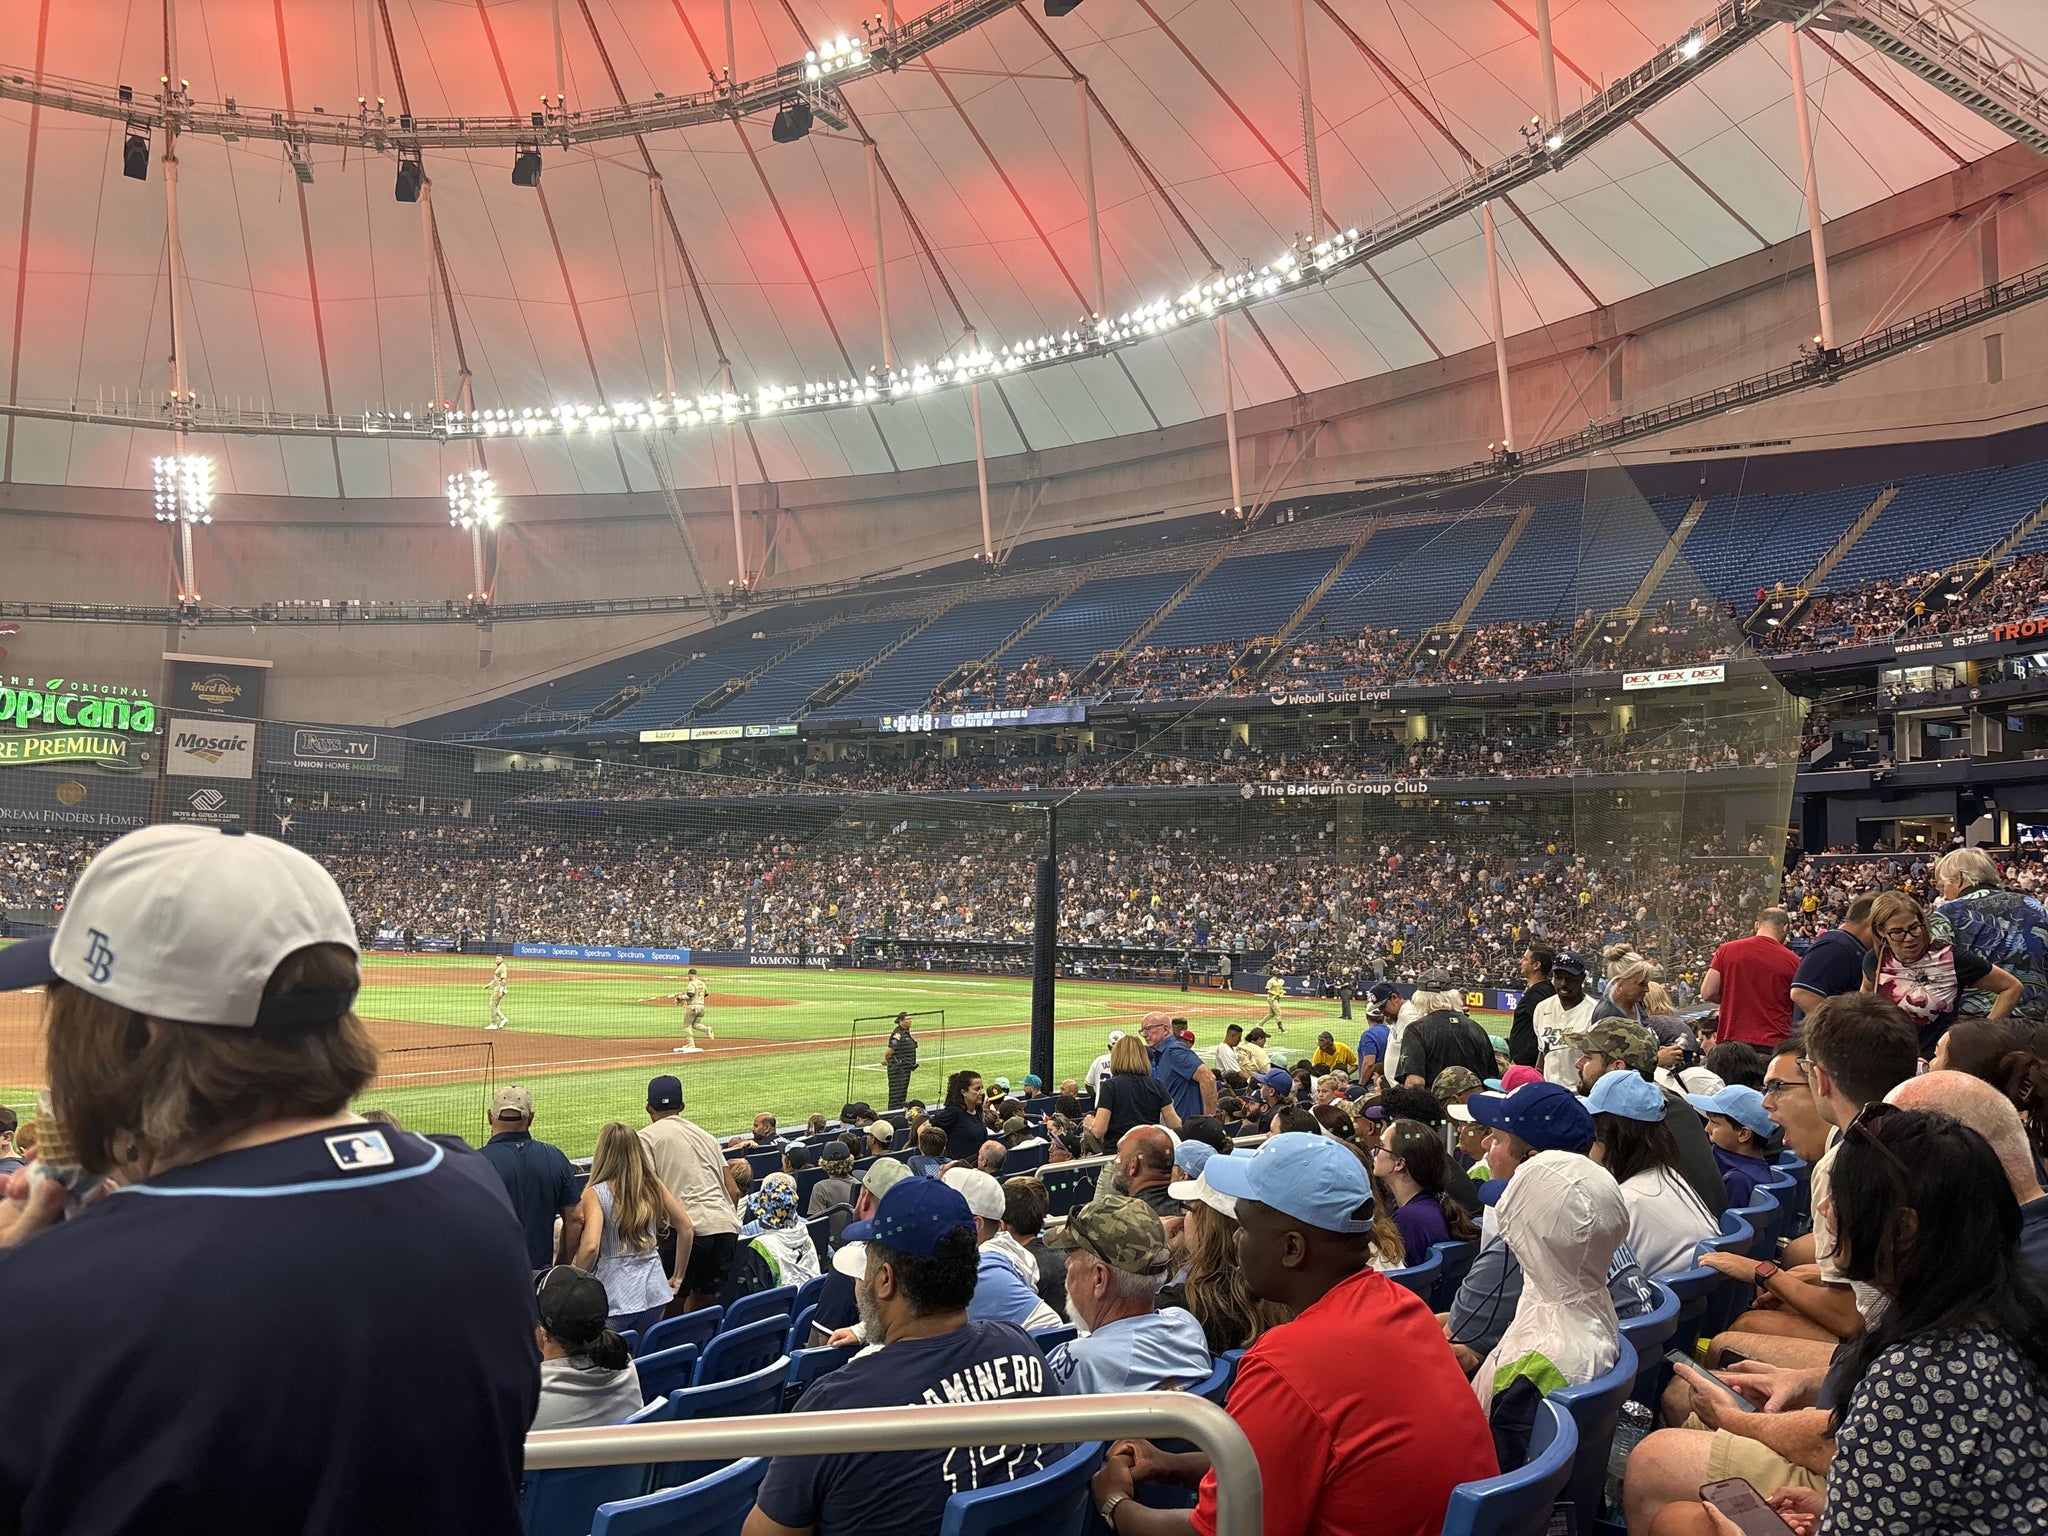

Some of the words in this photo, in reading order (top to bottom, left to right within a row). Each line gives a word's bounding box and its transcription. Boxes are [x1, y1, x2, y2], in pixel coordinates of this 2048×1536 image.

[1894, 643, 1923, 653] WQBN
[1953, 636, 1973, 647] 95.7
[1625, 674, 1652, 684] DEX
[1657, 671, 1685, 681] DEX
[1691, 668, 1719, 678] DEX
[70, 682, 149, 697] ORIGINAL
[191, 681, 217, 693] Hard
[217, 684, 242, 696] Rock
[1289, 692, 1325, 704] Webull
[1327, 691, 1357, 702] Suite
[1360, 688, 1390, 700] Level
[23, 736, 127, 757] PREMIUM
[174, 733, 248, 751] Mosaic
[294, 760, 323, 769] UNION
[324, 762, 351, 770] HOME
[352, 763, 400, 773] MORTGAGE
[1259, 785, 1285, 796] The
[1287, 783, 1344, 796] Baldwin
[1347, 784, 1391, 796] Group
[1394, 781, 1428, 793] Club
[44, 810, 95, 823] FINDERS
[99, 813, 144, 826] HOMES
[83, 927, 115, 984] TB
[521, 946, 547, 954] Spectrum
[552, 947, 578, 956] Spectrum
[584, 949, 611, 958] Spectrum
[617, 950, 645, 959] Spectrum
[651, 951, 681, 961] Spectrum
[750, 956, 799, 965] RAYMOND
[1505, 993, 1517, 1010] TB
